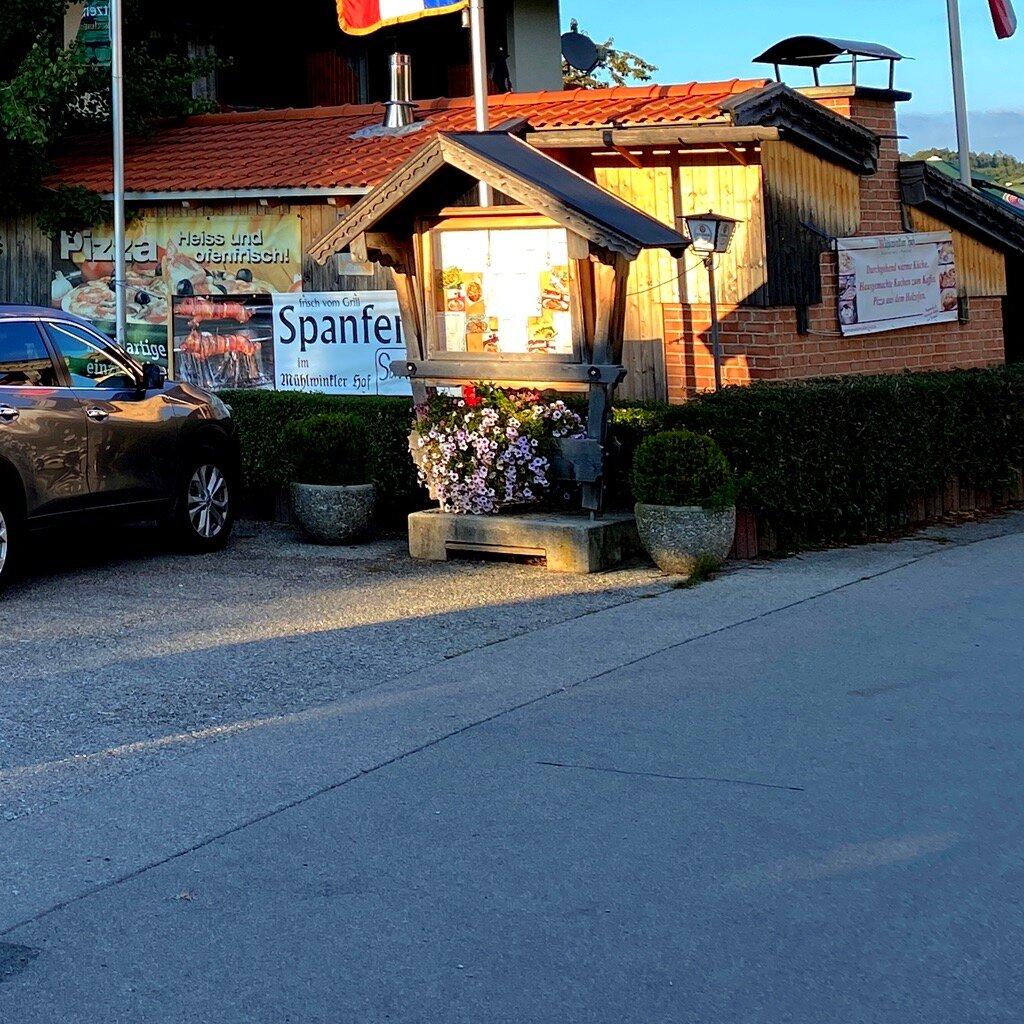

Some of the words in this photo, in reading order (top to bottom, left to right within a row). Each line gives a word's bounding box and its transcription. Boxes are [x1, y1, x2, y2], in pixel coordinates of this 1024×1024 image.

[178, 231, 225, 246] Heiss
[230, 230, 264, 246] und
[195, 247, 290, 264] ofenfrisch!
[299, 297, 320, 307] frisch
[323, 299, 340, 307] vom
[342, 297, 361, 307] Grill
[279, 304, 403, 352] Spanfer
[126, 339, 167, 360] artige
[281, 373, 348, 389] Mühlwinkler
[353, 374, 371, 390] Hof
